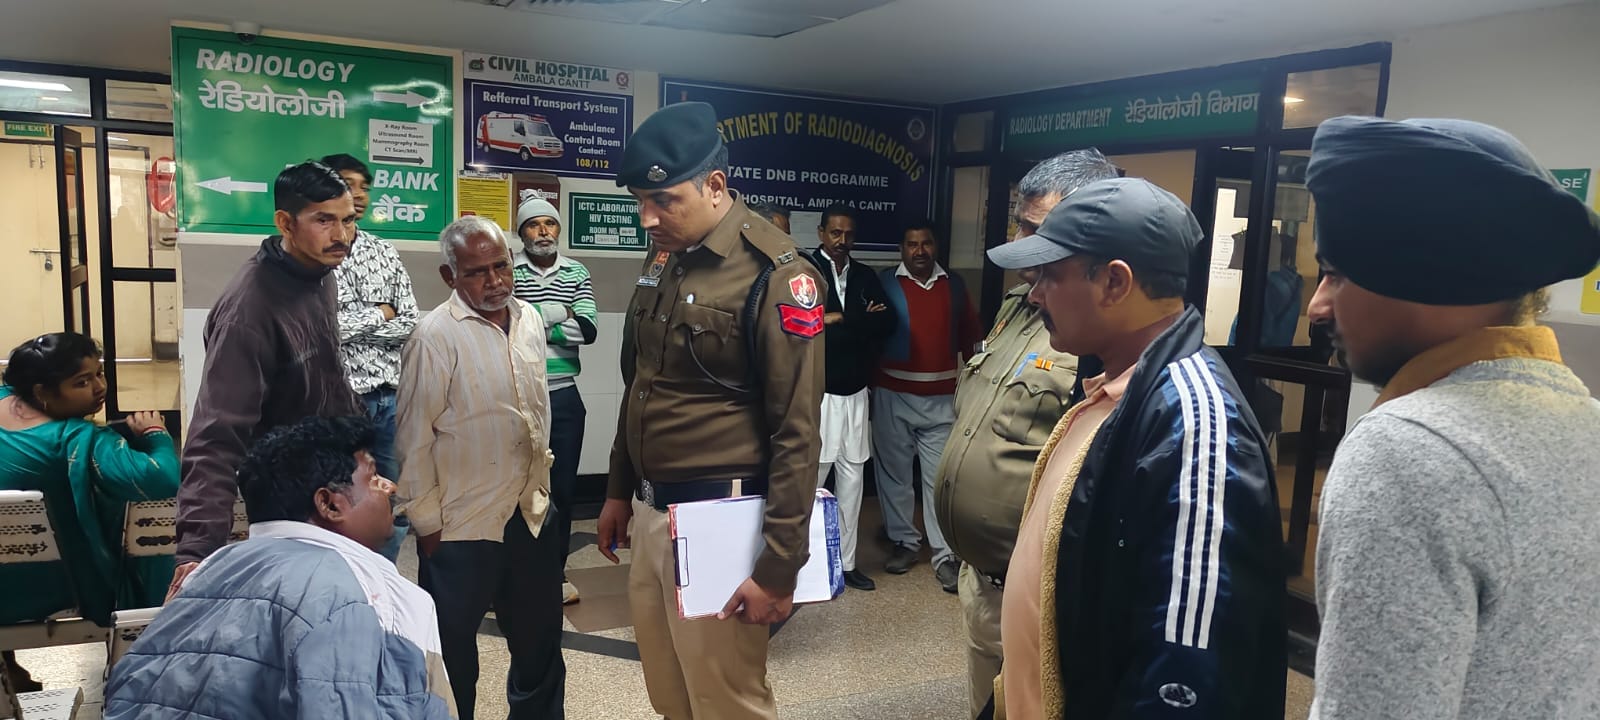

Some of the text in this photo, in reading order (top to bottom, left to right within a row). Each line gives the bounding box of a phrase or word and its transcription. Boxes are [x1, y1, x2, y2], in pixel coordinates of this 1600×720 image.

[196, 48, 355, 83] RADIOLOGY
[488, 56, 609, 82] CIVIL HOSPITAL
[513, 73, 590, 89] AMBALA CANTT
[198, 79, 347, 118] रेडियोलोजी
[483, 91, 618, 115] Refferral Transport System
[1206, 90, 1260, 115] विभाग
[570, 121, 615, 134] Ambulance
[1009, 108, 1112, 135] RADIOLOGY DEPARTMENT
[564, 134, 621, 147] Control Room
[784, 112, 803, 134] OF
[808, 114, 924, 183] RADIODIAGNOSIS
[579, 146, 607, 155] Contact:
[576, 158, 609, 169] 108/112
[373, 169, 440, 192] BANK
[766, 169, 796, 182] DNB
[801, 171, 889, 187] PROGRAMME
[371, 193, 429, 222] बैंक
[578, 201, 595, 211] ICTC
[859, 201, 897, 212] CANTT
[589, 214, 632, 224] HIV TESTING
[581, 235, 594, 243] OPD
